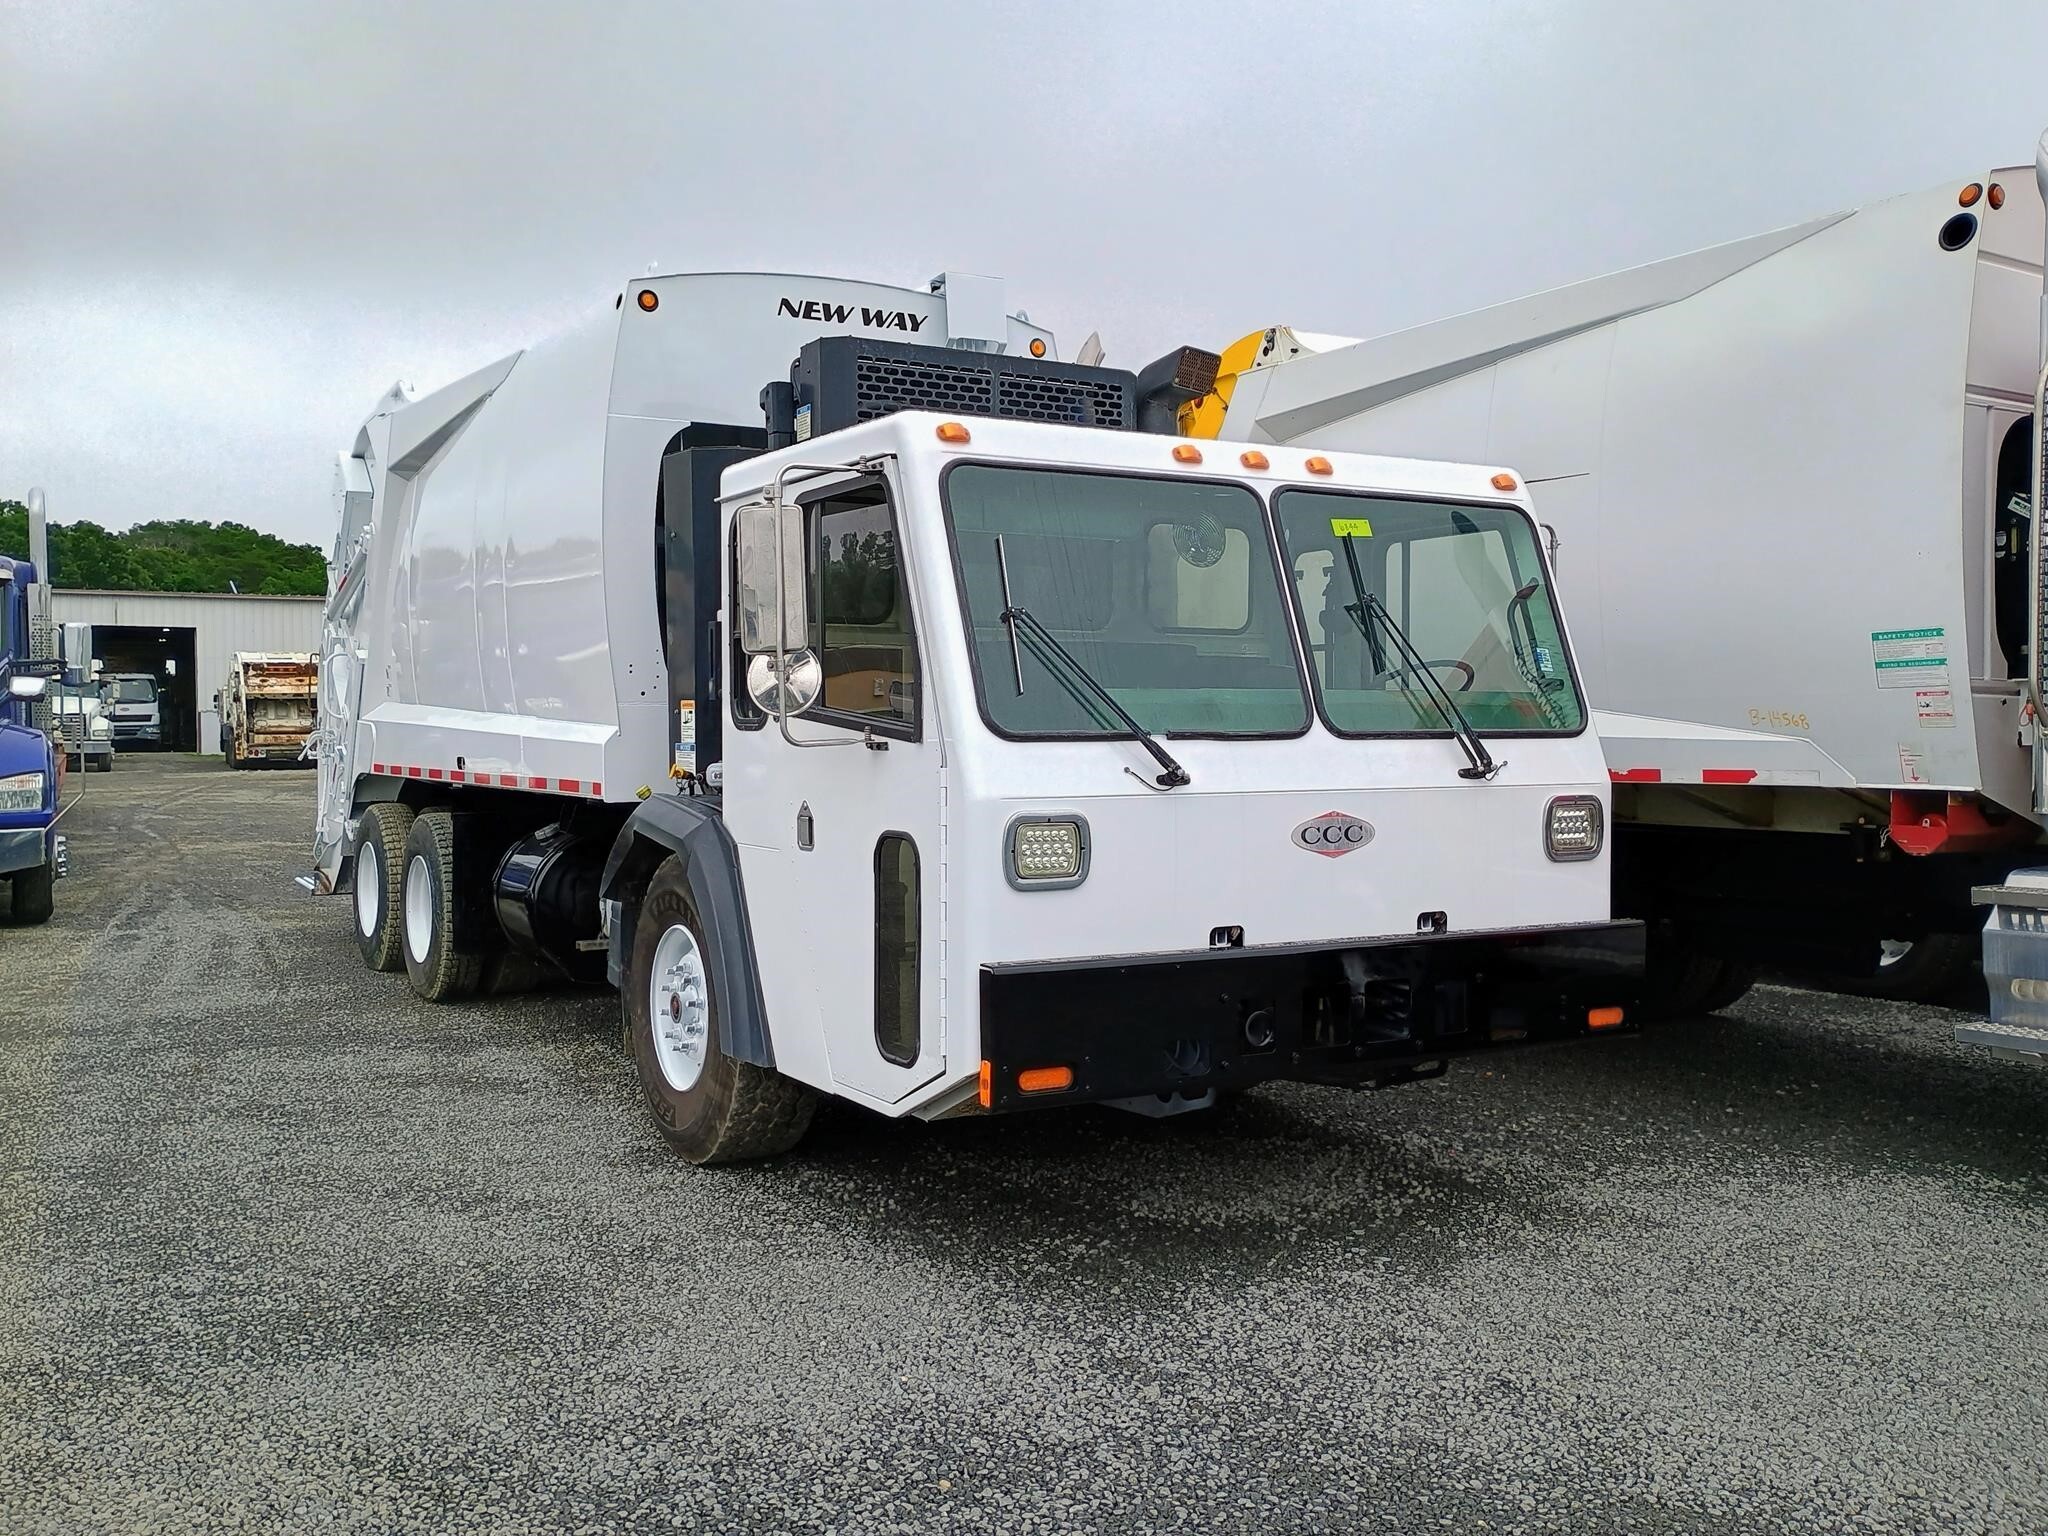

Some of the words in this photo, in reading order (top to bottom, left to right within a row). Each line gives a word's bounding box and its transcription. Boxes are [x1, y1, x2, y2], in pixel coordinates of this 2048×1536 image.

[778, 297, 855, 324] NEW
[861, 307, 929, 333] WAY
[1301, 825, 1363, 844] CCC
